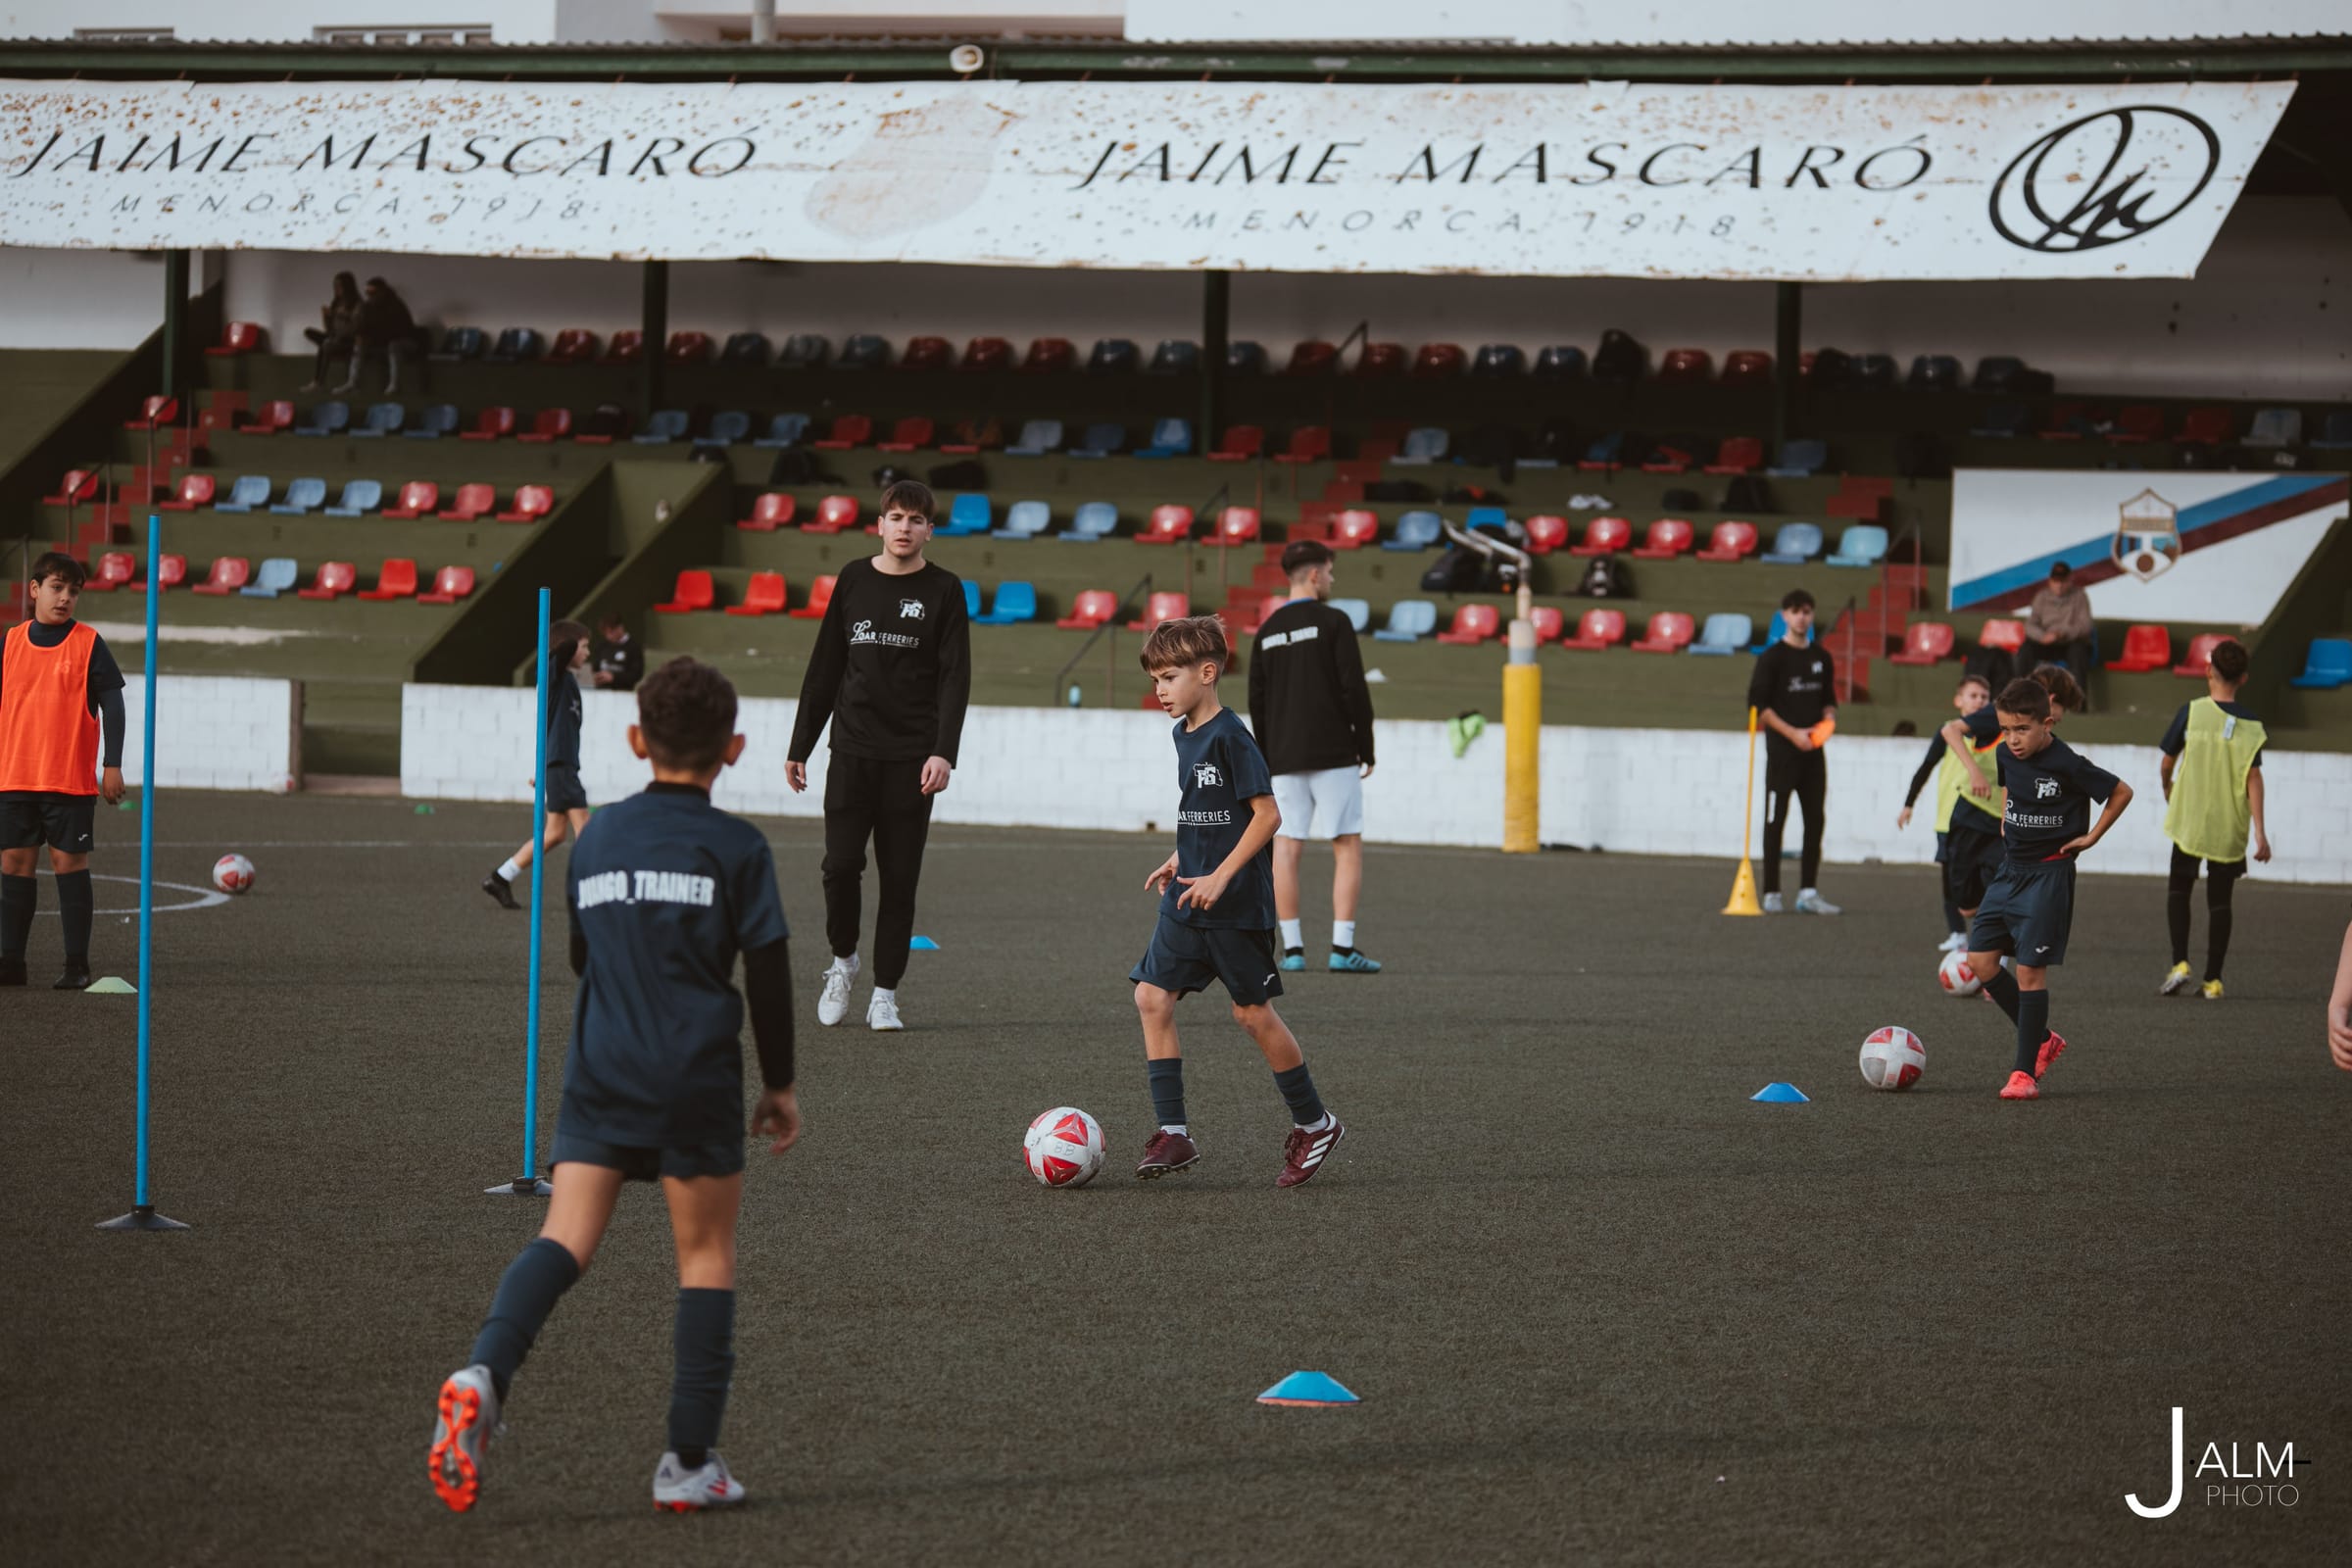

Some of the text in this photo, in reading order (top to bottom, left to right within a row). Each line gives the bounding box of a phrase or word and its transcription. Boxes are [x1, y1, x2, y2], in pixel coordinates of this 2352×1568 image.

[7, 125, 760, 179] JAIME MASCARÓ
[1066, 133, 1933, 191] JAIME MASCARÓ
[109, 193, 399, 215] MENORCA
[1181, 209, 1736, 237] MENORCA 1918
[878, 632, 920, 647] FERRERIES
[1187, 809, 1231, 823] FERRERIES
[2019, 813, 2063, 825] FERRERIES
